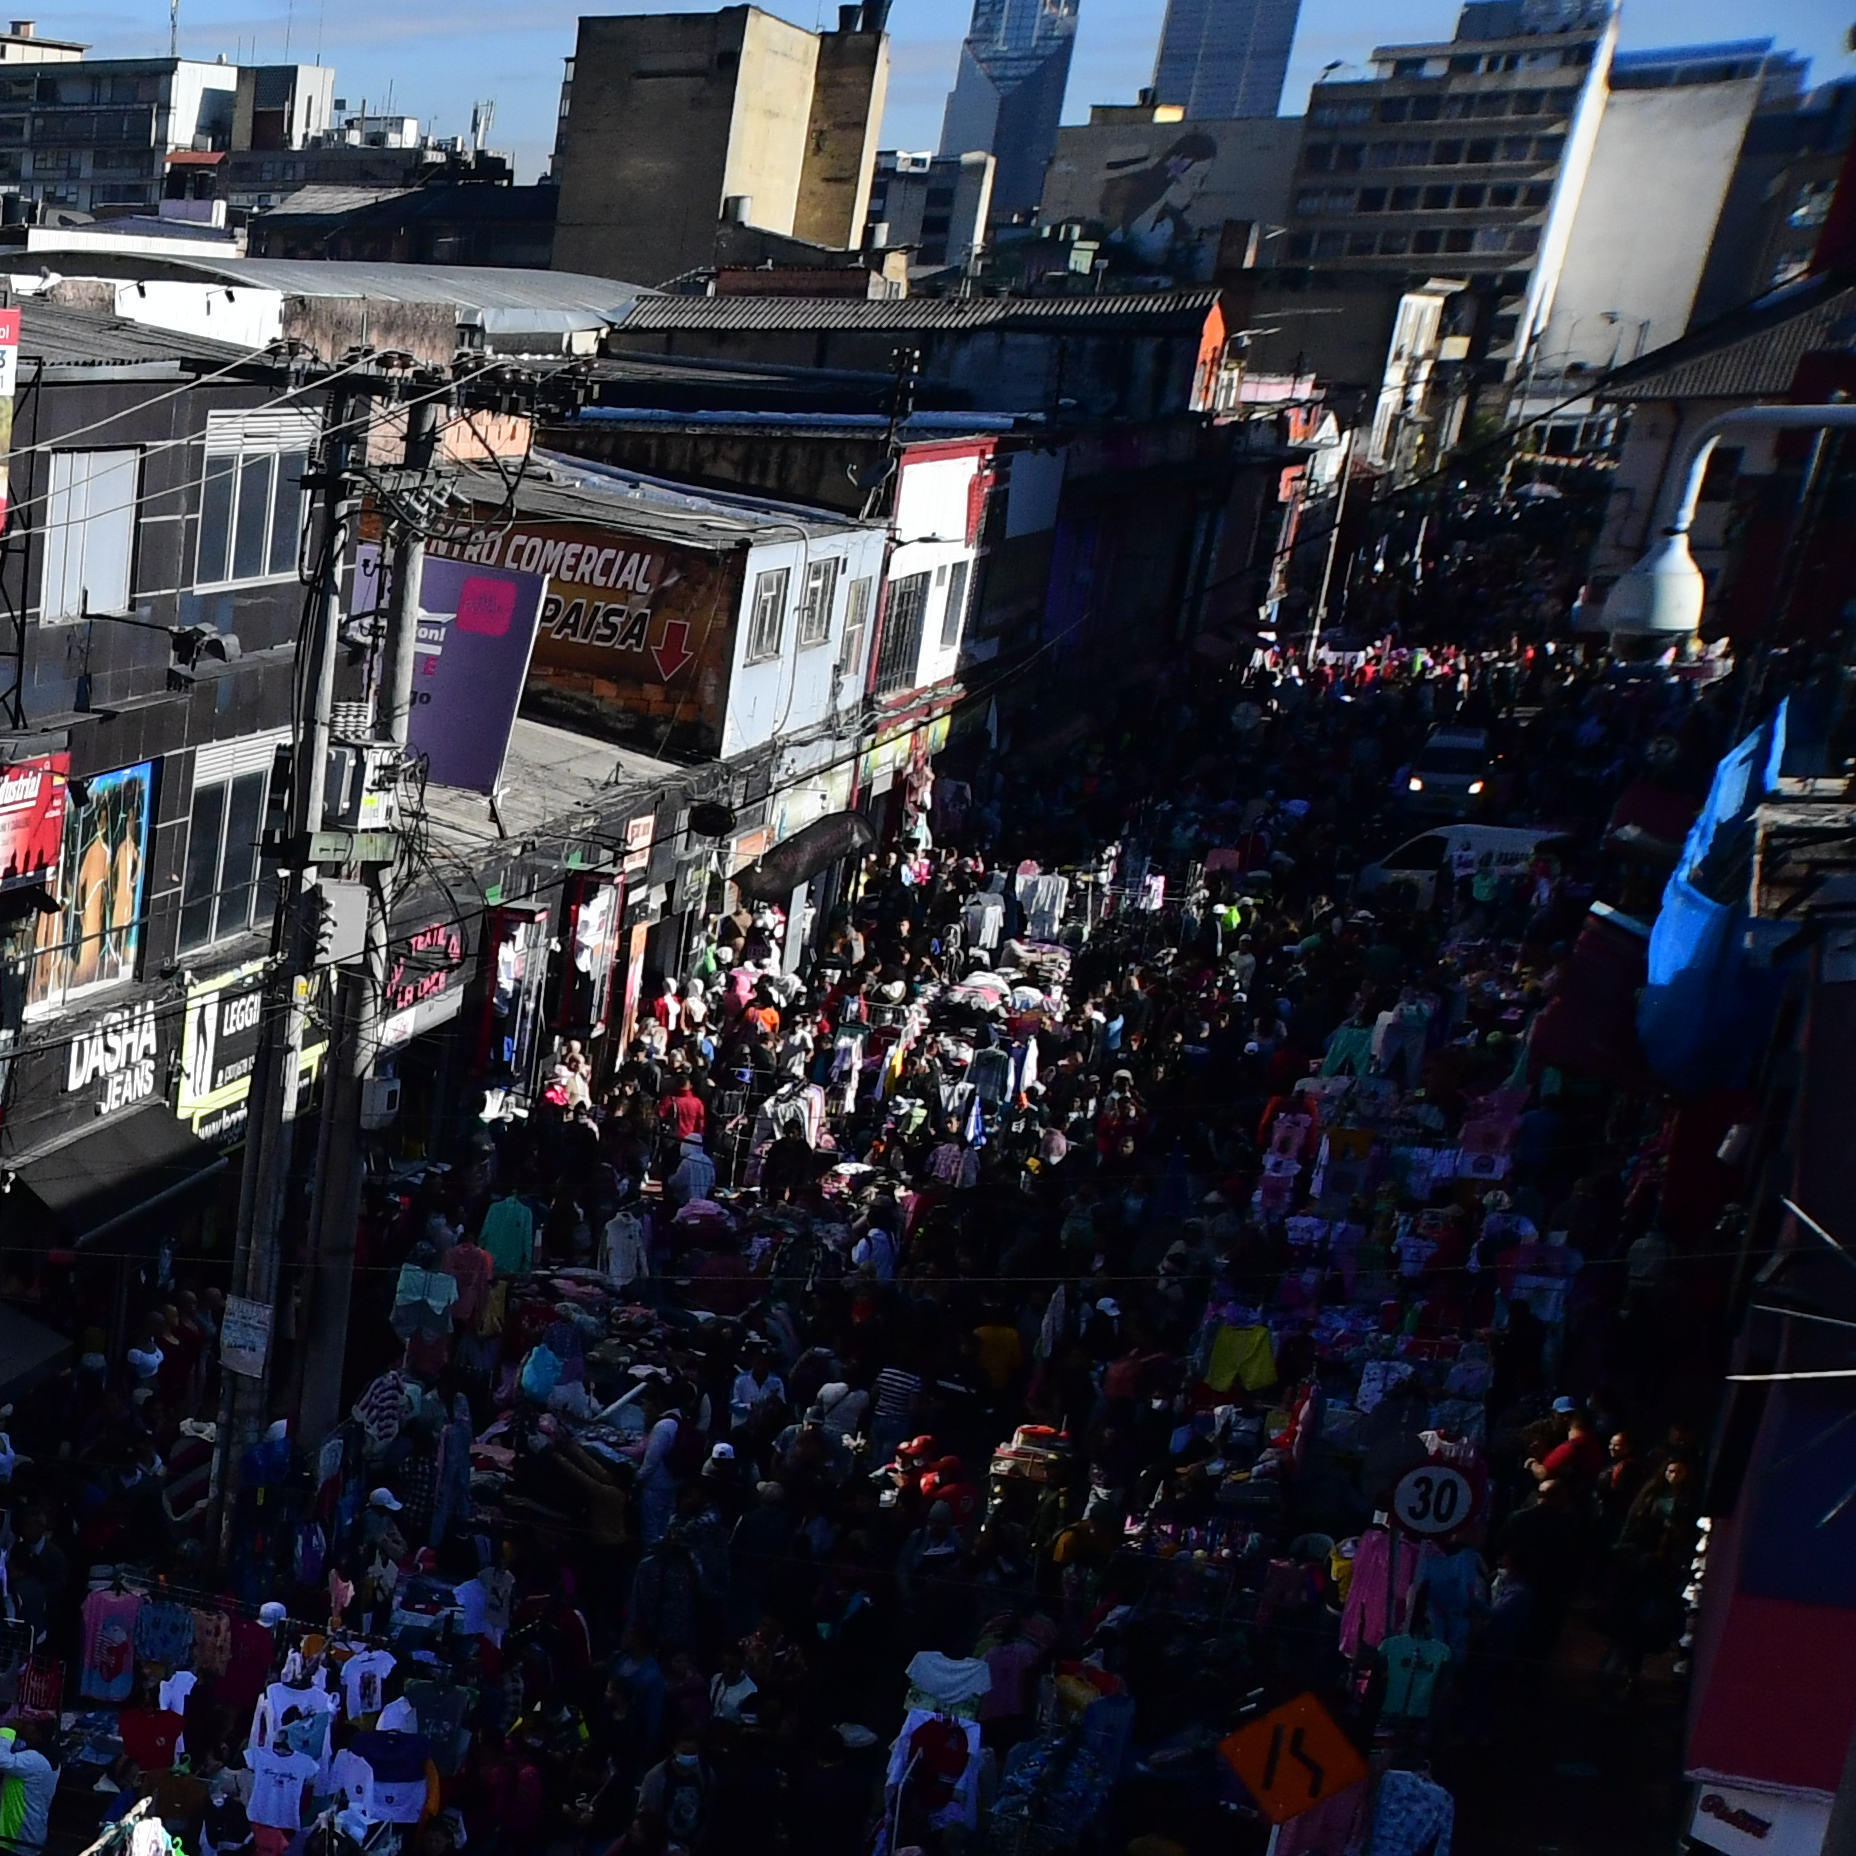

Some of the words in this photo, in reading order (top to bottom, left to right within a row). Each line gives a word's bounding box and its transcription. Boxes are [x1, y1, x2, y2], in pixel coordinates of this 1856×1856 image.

[504, 534, 652, 595] COMERCIAL
[538, 594, 652, 653] PAISA
[67, 999, 157, 1092] DASHA
[95, 1059, 156, 1116] JEANS
[1407, 1475, 1458, 1524] 30
